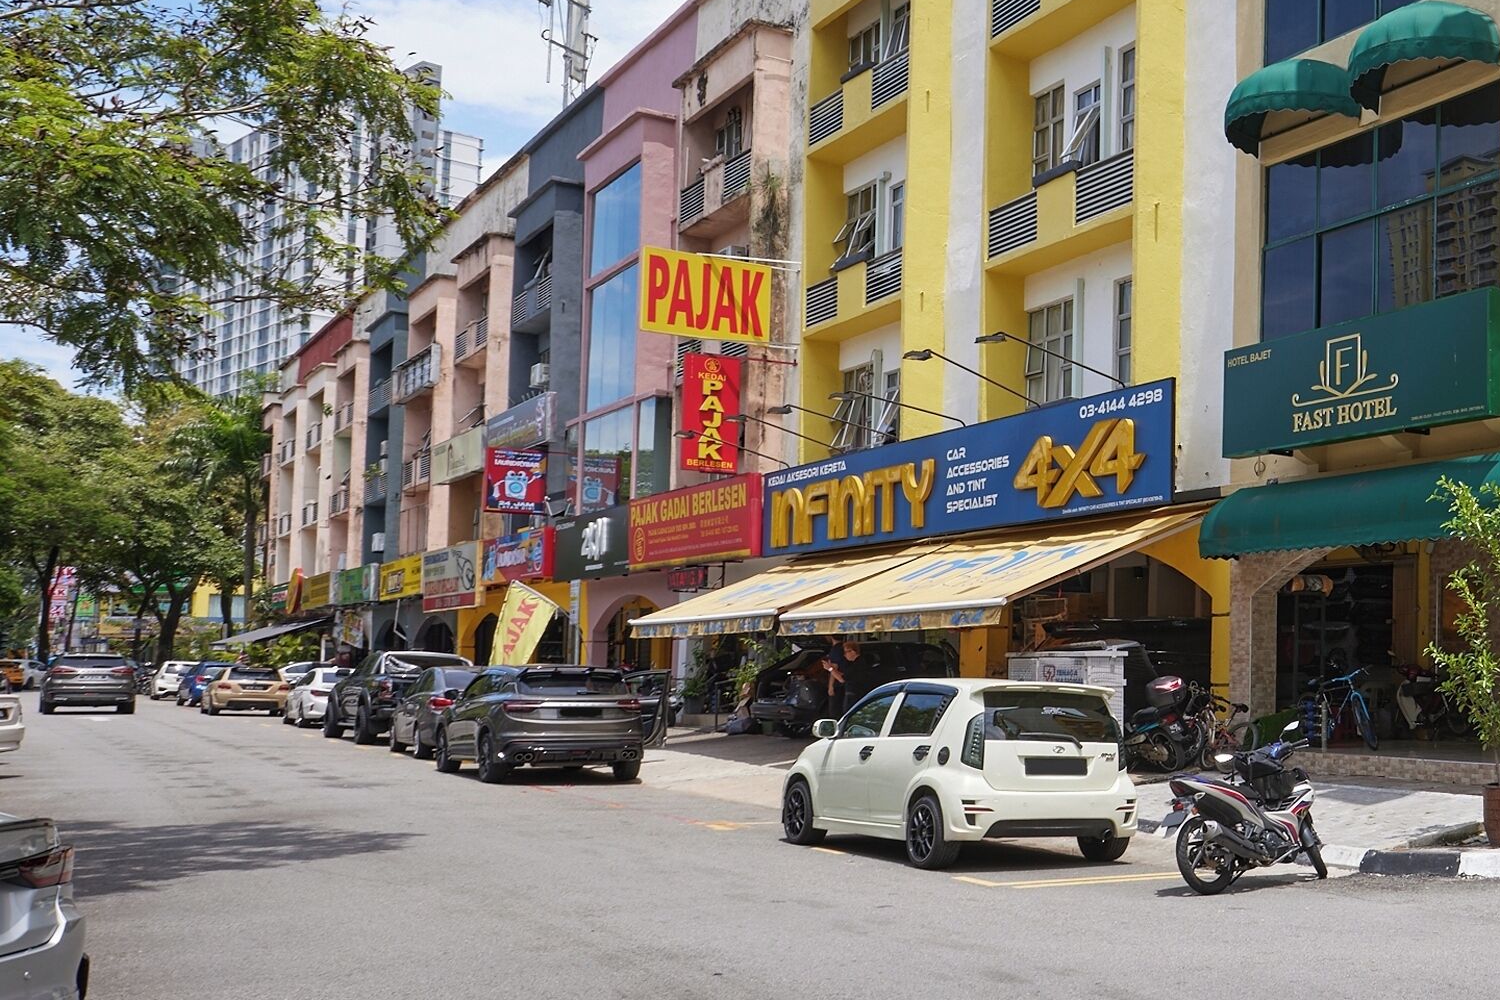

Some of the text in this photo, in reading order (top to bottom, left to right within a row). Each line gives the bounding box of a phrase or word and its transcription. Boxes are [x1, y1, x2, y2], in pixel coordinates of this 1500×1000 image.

[647, 254, 764, 337] PAJAK
[1227, 349, 1272, 368] HOTEL BAJET
[698, 372, 727, 381] KEDAI
[1079, 388, 1163, 419] 03-4144 4298
[1292, 406, 1336, 433] FAST
[1337, 396, 1397, 425] HOTEL
[698, 379, 725, 461] PAJAK
[686, 459, 733, 469] BERLESEN
[946, 446, 966, 461] CAR
[768, 460, 847, 487] KEDAI AKSESORI KERETA
[946, 455, 1010, 479] ACCESSORIES
[946, 477, 987, 496] AND TINT
[630, 483, 747, 527] PAJAK GADAI BERLESEN
[946, 493, 998, 514] SPECIALIST
